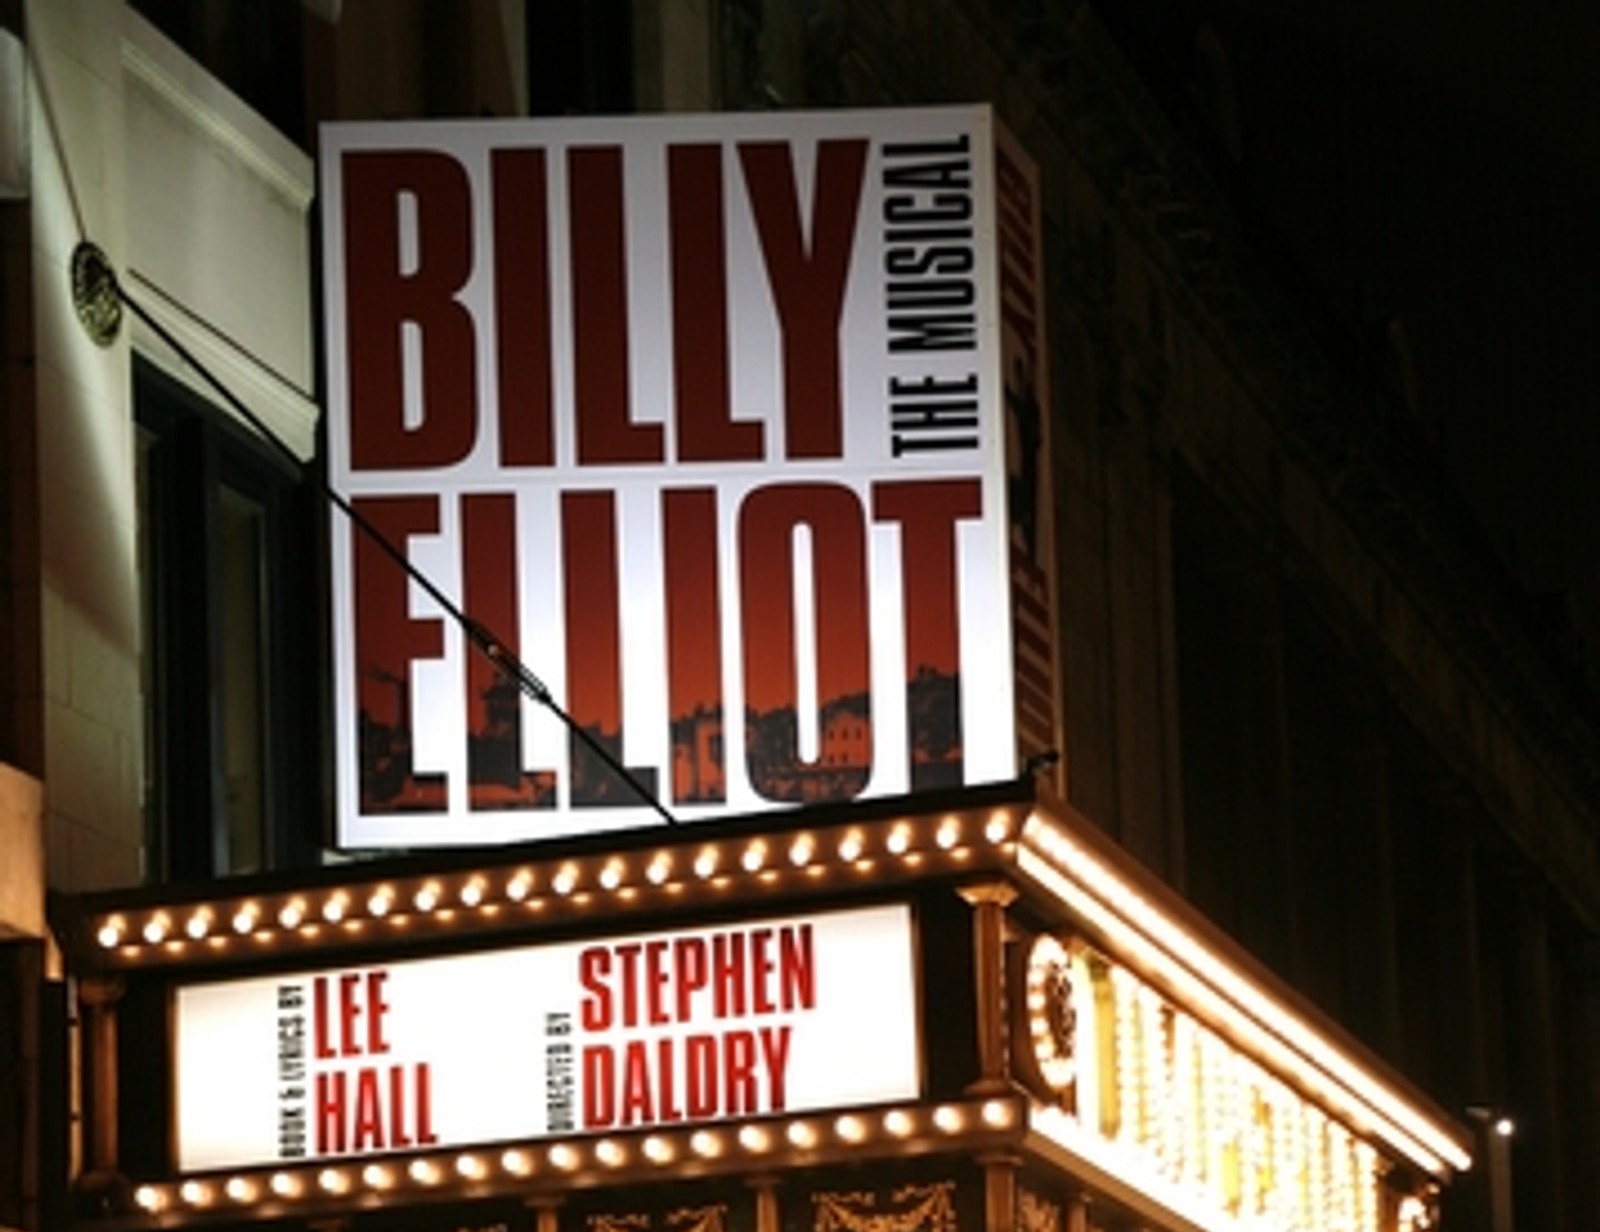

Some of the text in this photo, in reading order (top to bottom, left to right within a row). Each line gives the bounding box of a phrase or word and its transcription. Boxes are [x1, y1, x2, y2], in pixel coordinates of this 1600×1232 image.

[340, 137, 871, 471] BILLY
[882, 133, 979, 458] THE MUSICAL
[349, 476, 983, 816] ELLIOT
[278, 985, 304, 1010] BY
[314, 972, 390, 1059] LEE
[579, 923, 816, 1032] STEPHEN
[278, 1015, 306, 1081] LYRICS
[546, 1012, 575, 1132] DIRECTED BY
[582, 1025, 792, 1132] DALDRY
[278, 1107, 306, 1158] BOOK
[317, 1063, 438, 1156] HALL
